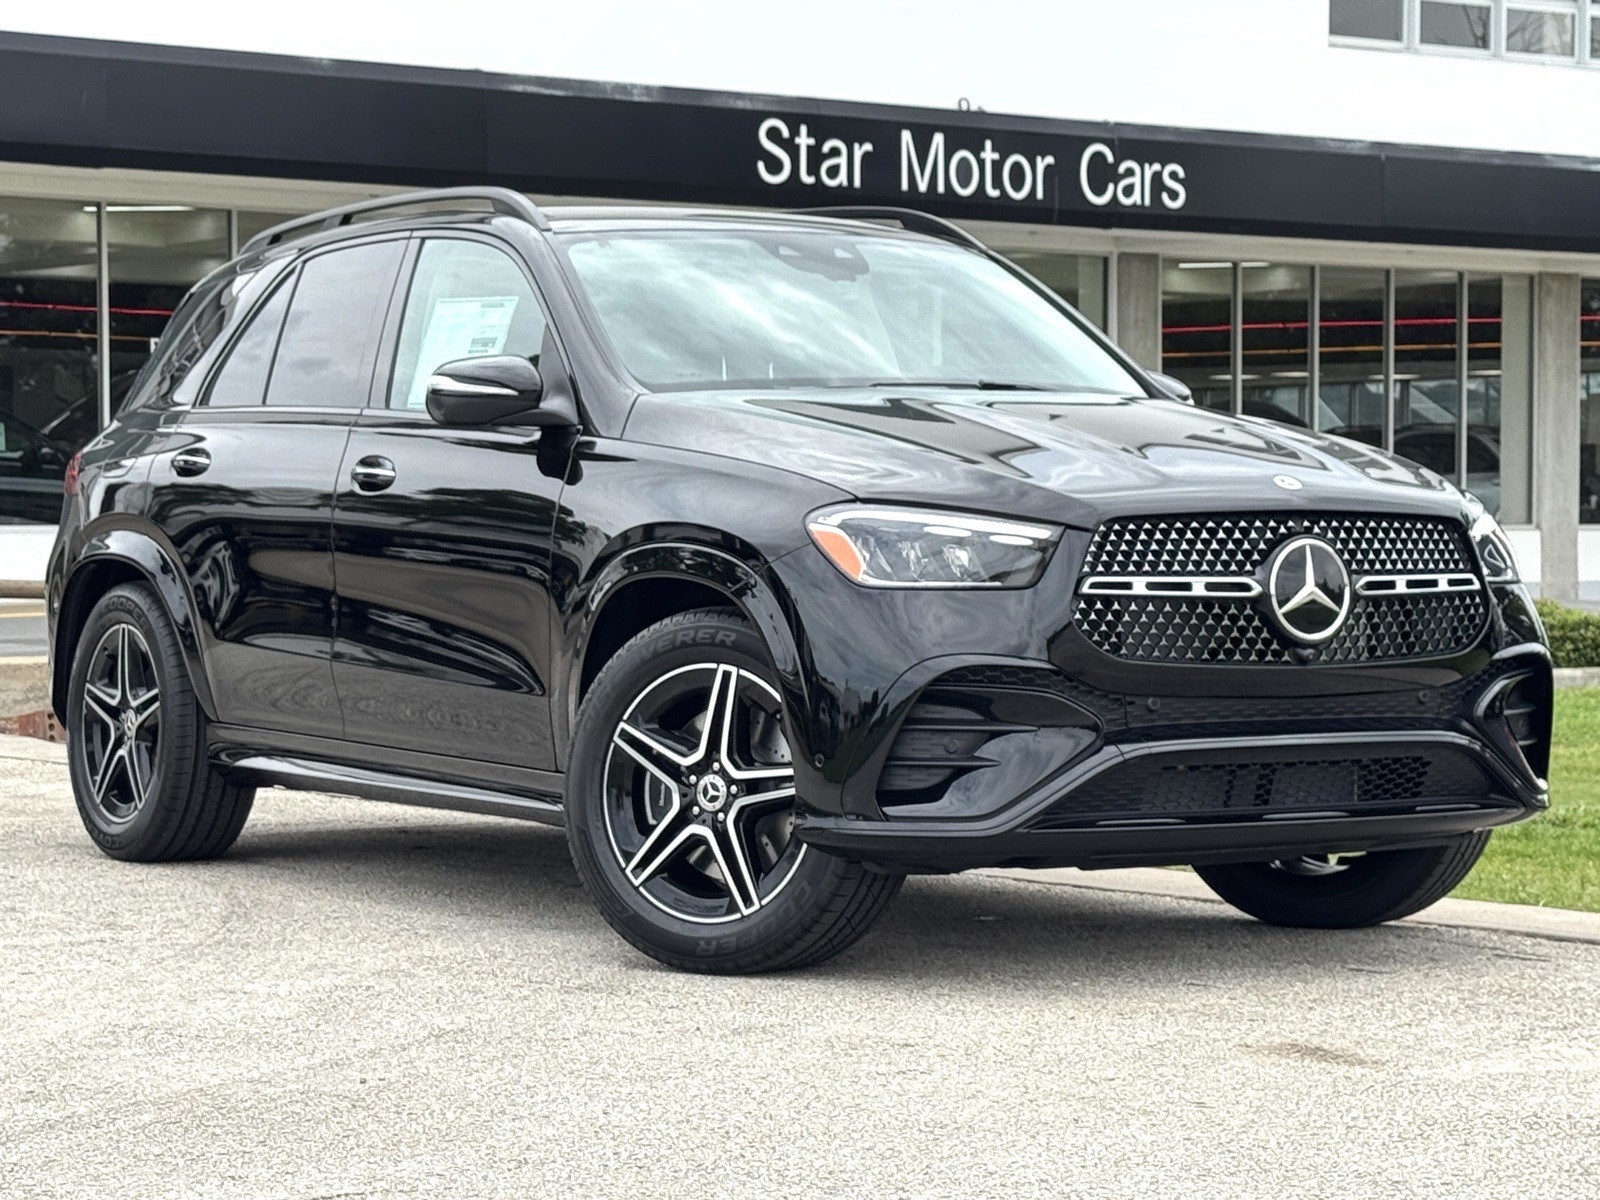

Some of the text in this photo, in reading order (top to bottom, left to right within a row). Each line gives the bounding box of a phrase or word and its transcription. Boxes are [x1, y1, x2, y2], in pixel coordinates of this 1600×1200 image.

[756, 117, 1187, 210] Star Motor Cars
